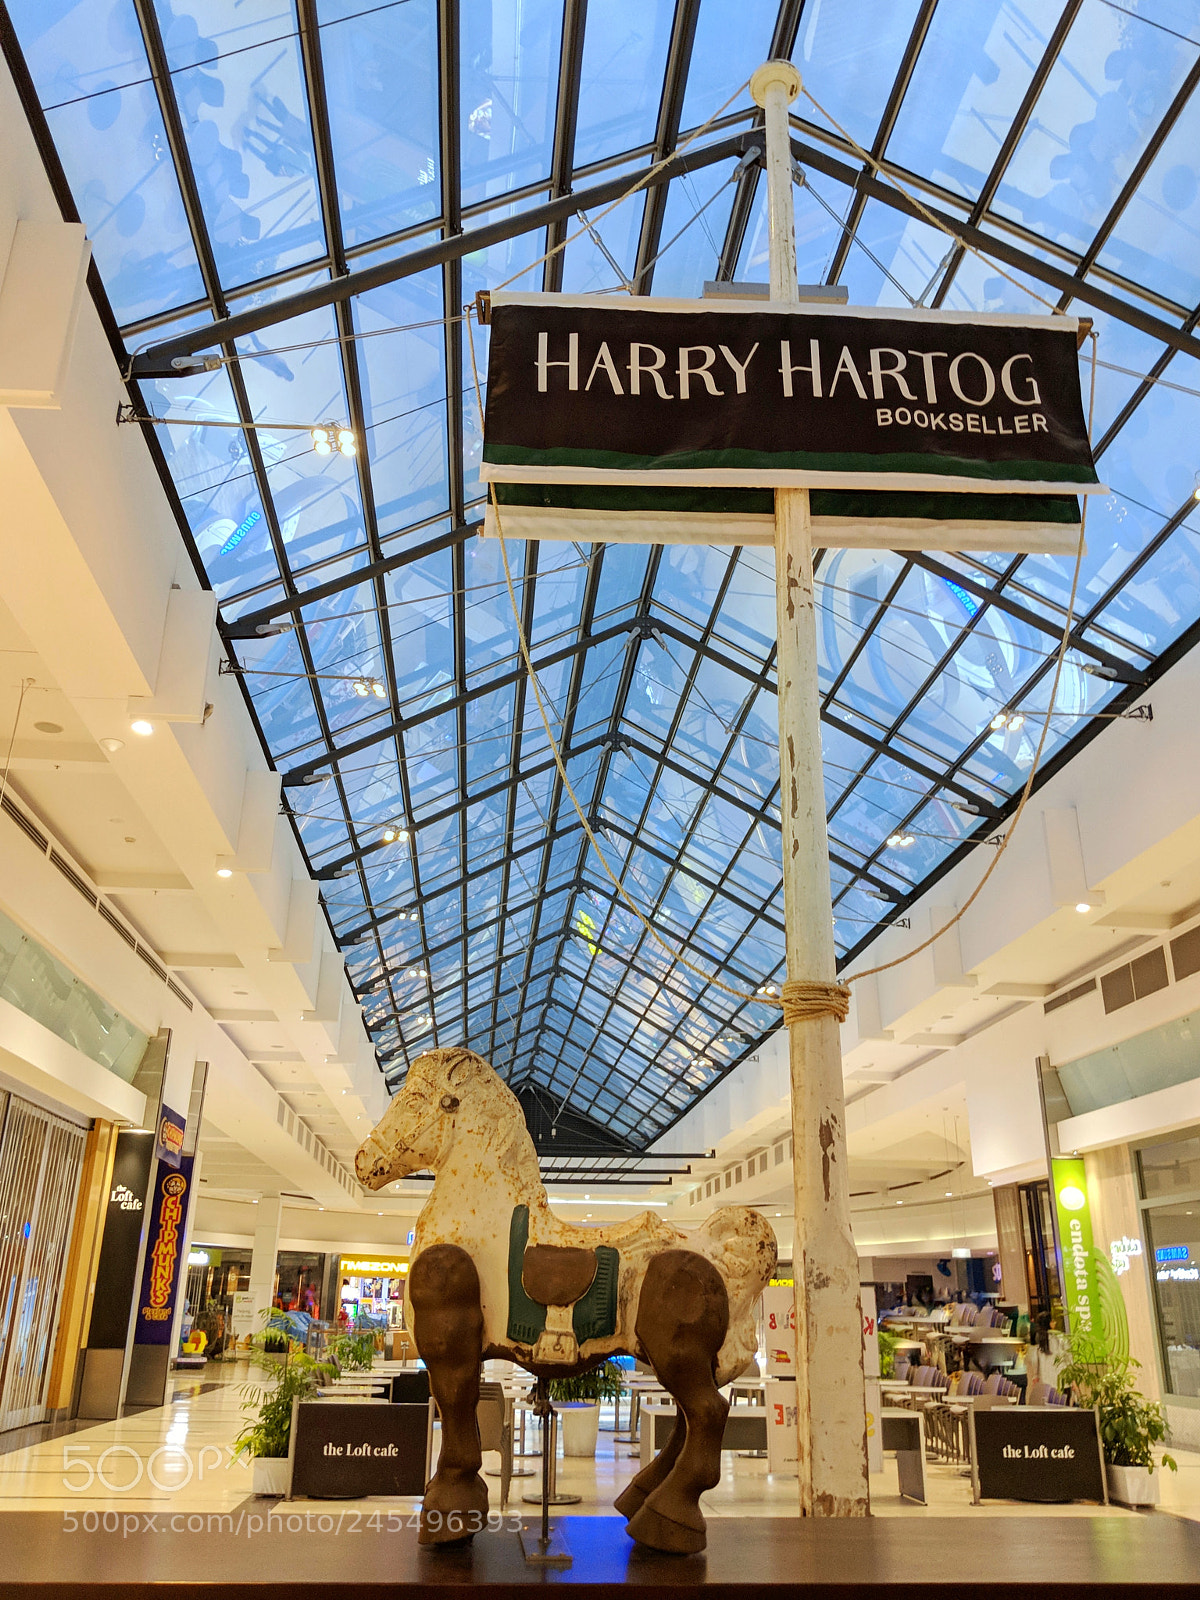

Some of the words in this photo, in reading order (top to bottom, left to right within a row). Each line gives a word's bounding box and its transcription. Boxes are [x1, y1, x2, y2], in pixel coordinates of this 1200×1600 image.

[534, 332, 759, 399] HARRY
[778, 339, 1042, 406] HARTOG
[876, 407, 1049, 435] BOOKSELLER
[110, 1190, 133, 1201] Loft
[120, 1198, 143, 1210] cafe
[151, 1195, 181, 1306] CHIPMUNKS
[1069, 1218, 1089, 1291] endota
[340, 1260, 409, 1273] TIMEZONE
[323, 1442, 343, 1456] the
[346, 1442, 371, 1456] Loft
[373, 1443, 399, 1457] cafe
[1002, 1444, 1022, 1458] the
[1024, 1444, 1049, 1458] Loft
[1050, 1444, 1075, 1458] cafe
